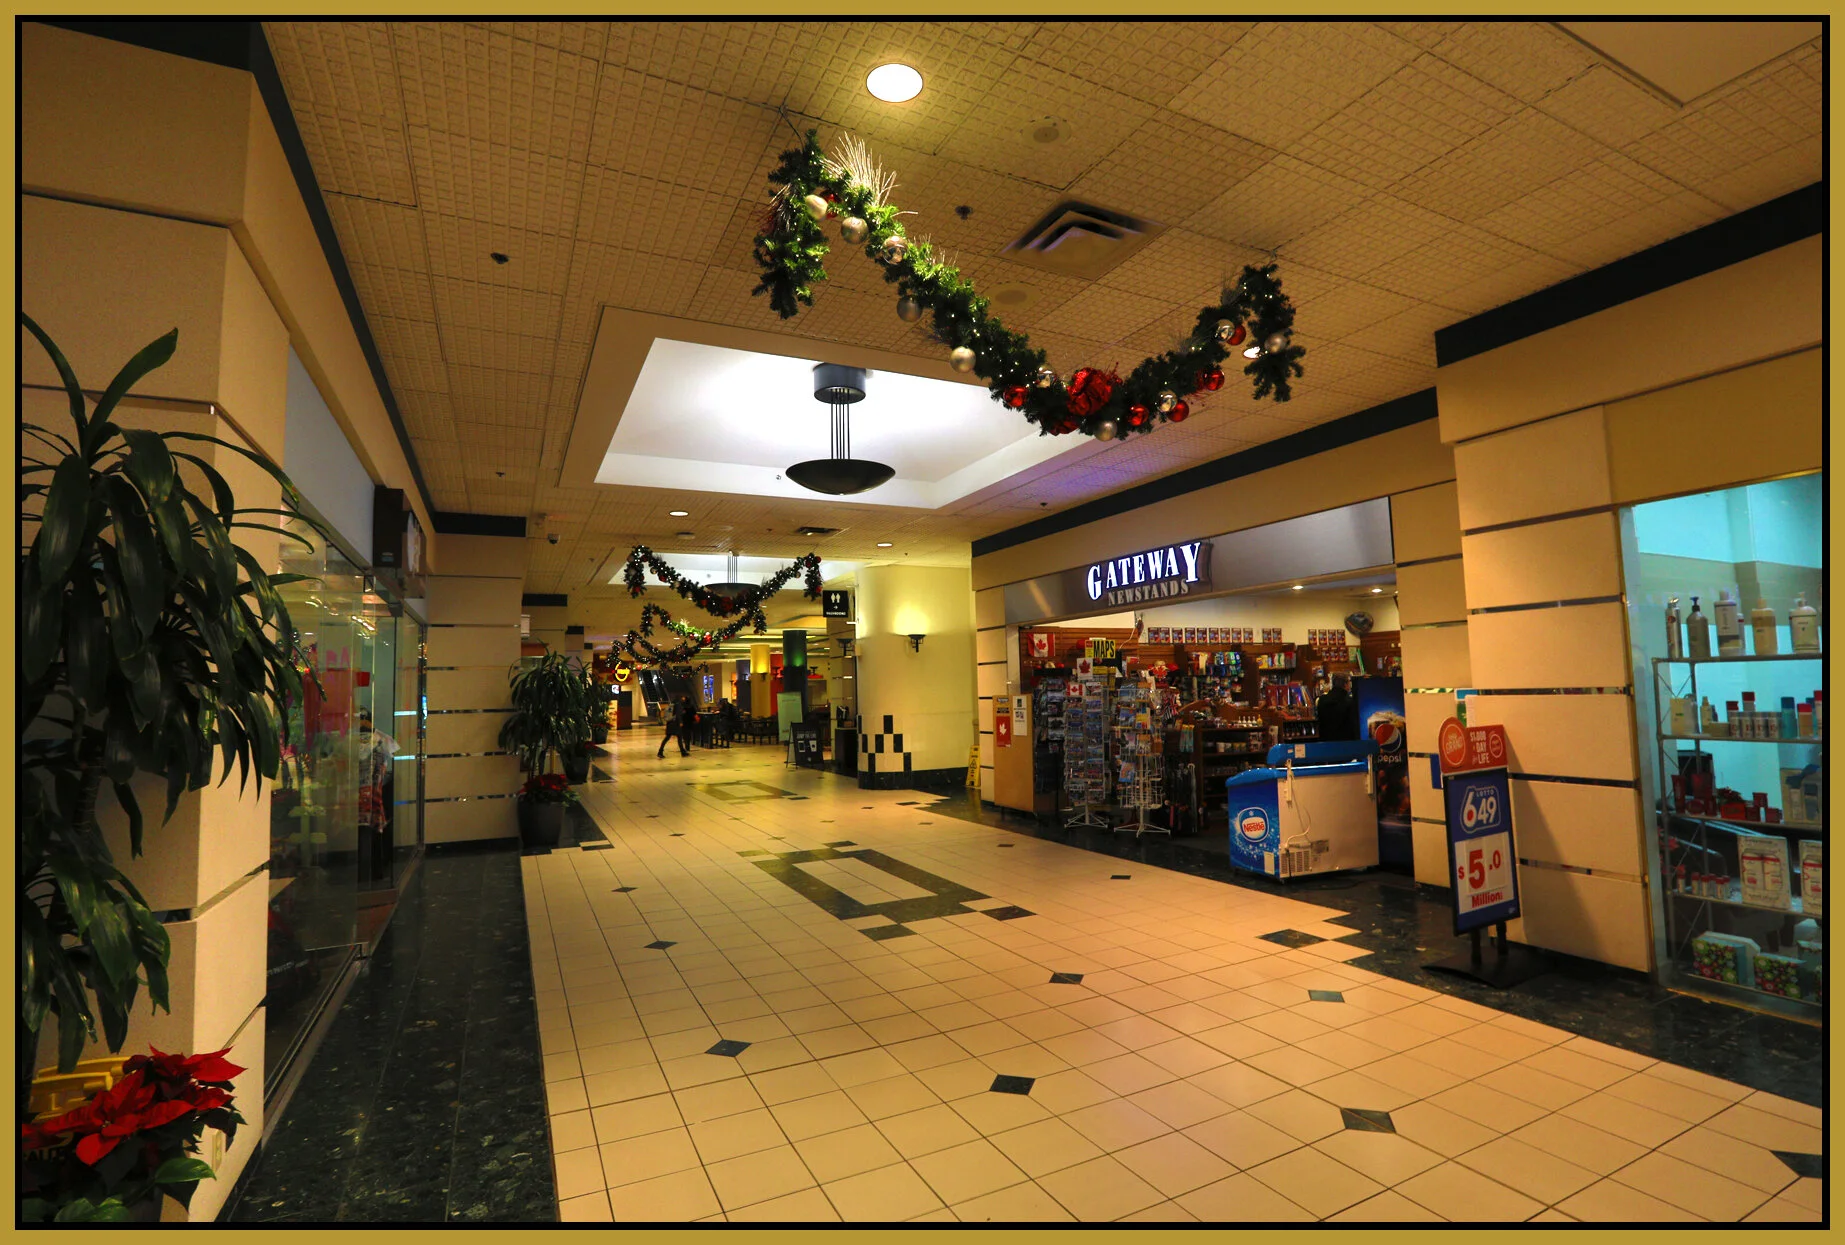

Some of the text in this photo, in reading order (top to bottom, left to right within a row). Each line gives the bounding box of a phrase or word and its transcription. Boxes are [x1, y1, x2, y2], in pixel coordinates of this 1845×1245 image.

[1087, 542, 1200, 600] GATEWAY
[1108, 579, 1189, 606] NEWSTANDS
[1093, 640, 1115, 658] MAPS
[1476, 789, 1494, 797] LOTTO
